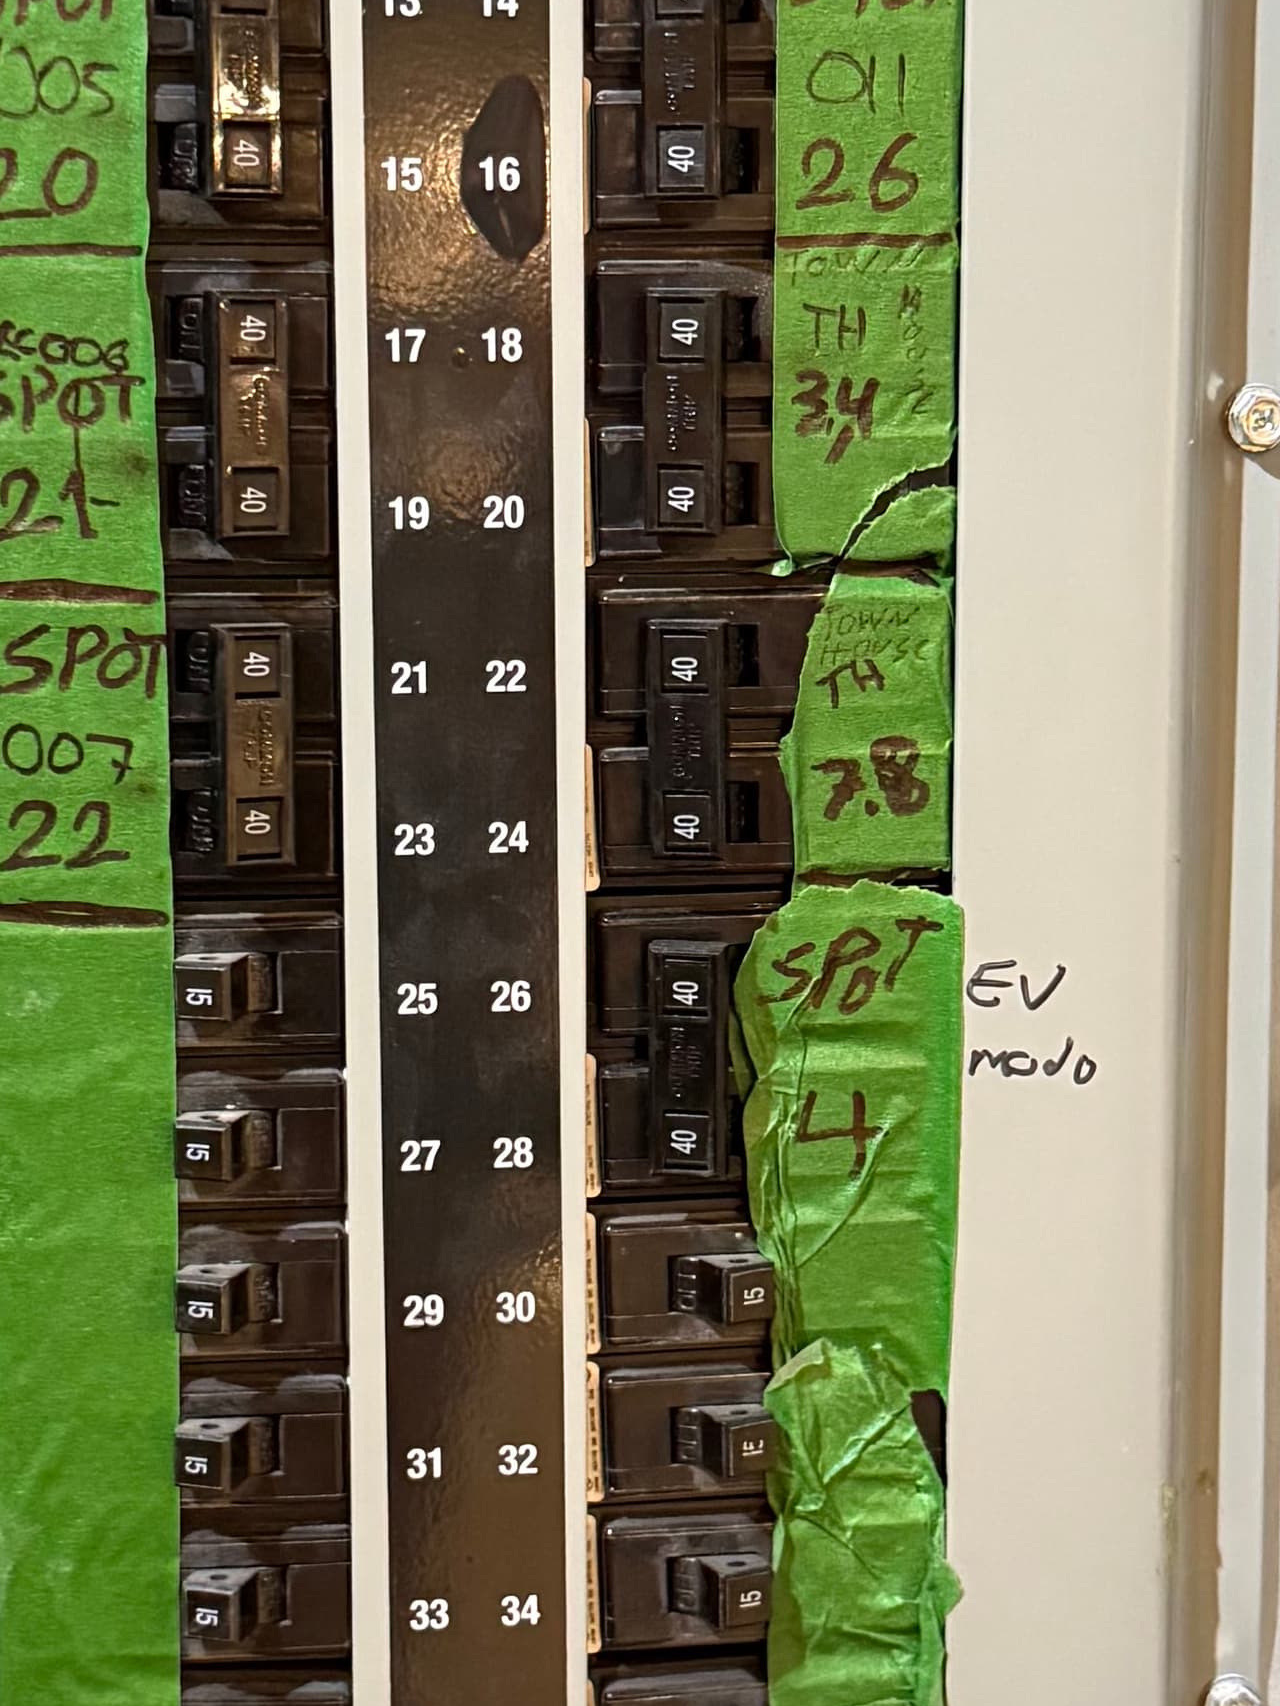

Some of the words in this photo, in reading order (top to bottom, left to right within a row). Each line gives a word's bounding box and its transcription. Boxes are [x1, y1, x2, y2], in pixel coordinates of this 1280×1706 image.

[806, 50, 907, 115] 011
[382, 157, 421, 192] 15
[479, 157, 520, 191] 16
[668, 146, 694, 172] 40
[795, 132, 920, 213] 26
[241, 316, 266, 342] 40
[802, 303, 867, 351] TH
[386, 328, 425, 362] 17
[482, 328, 522, 362] 18
[389, 496, 429, 529] 19
[484, 495, 524, 528] 20
[668, 487, 694, 511] 40
[244, 652, 269, 676] 40
[392, 661, 426, 694] 21
[486, 660, 526, 692] 22
[815, 659, 886, 709] TH
[2, 722, 133, 785] 007
[395, 824, 434, 855] 23
[489, 821, 528, 853] 24
[674, 815, 699, 839] 40
[757, 915, 945, 1016] SPOT
[186, 989, 212, 1005] 15
[398, 983, 437, 1014] 25
[491, 981, 531, 1011] 26
[966, 959, 1067, 1011] EV
[187, 1144, 209, 1160] 15
[671, 1130, 696, 1154] 40
[797, 1090, 890, 1180] 4
[401, 1140, 440, 1171] 27
[494, 1137, 533, 1168] 28
[189, 1301, 213, 1318] 15
[404, 1295, 443, 1326] 29
[497, 1292, 535, 1322] 30
[744, 1288, 764, 1305] 15
[407, 1448, 441, 1478] 31
[499, 1444, 537, 1475] 32
[410, 1599, 449, 1630] 33
[502, 1595, 540, 1626] 34
[740, 1591, 761, 1607] 15
[196, 1608, 218, 1625] 15
